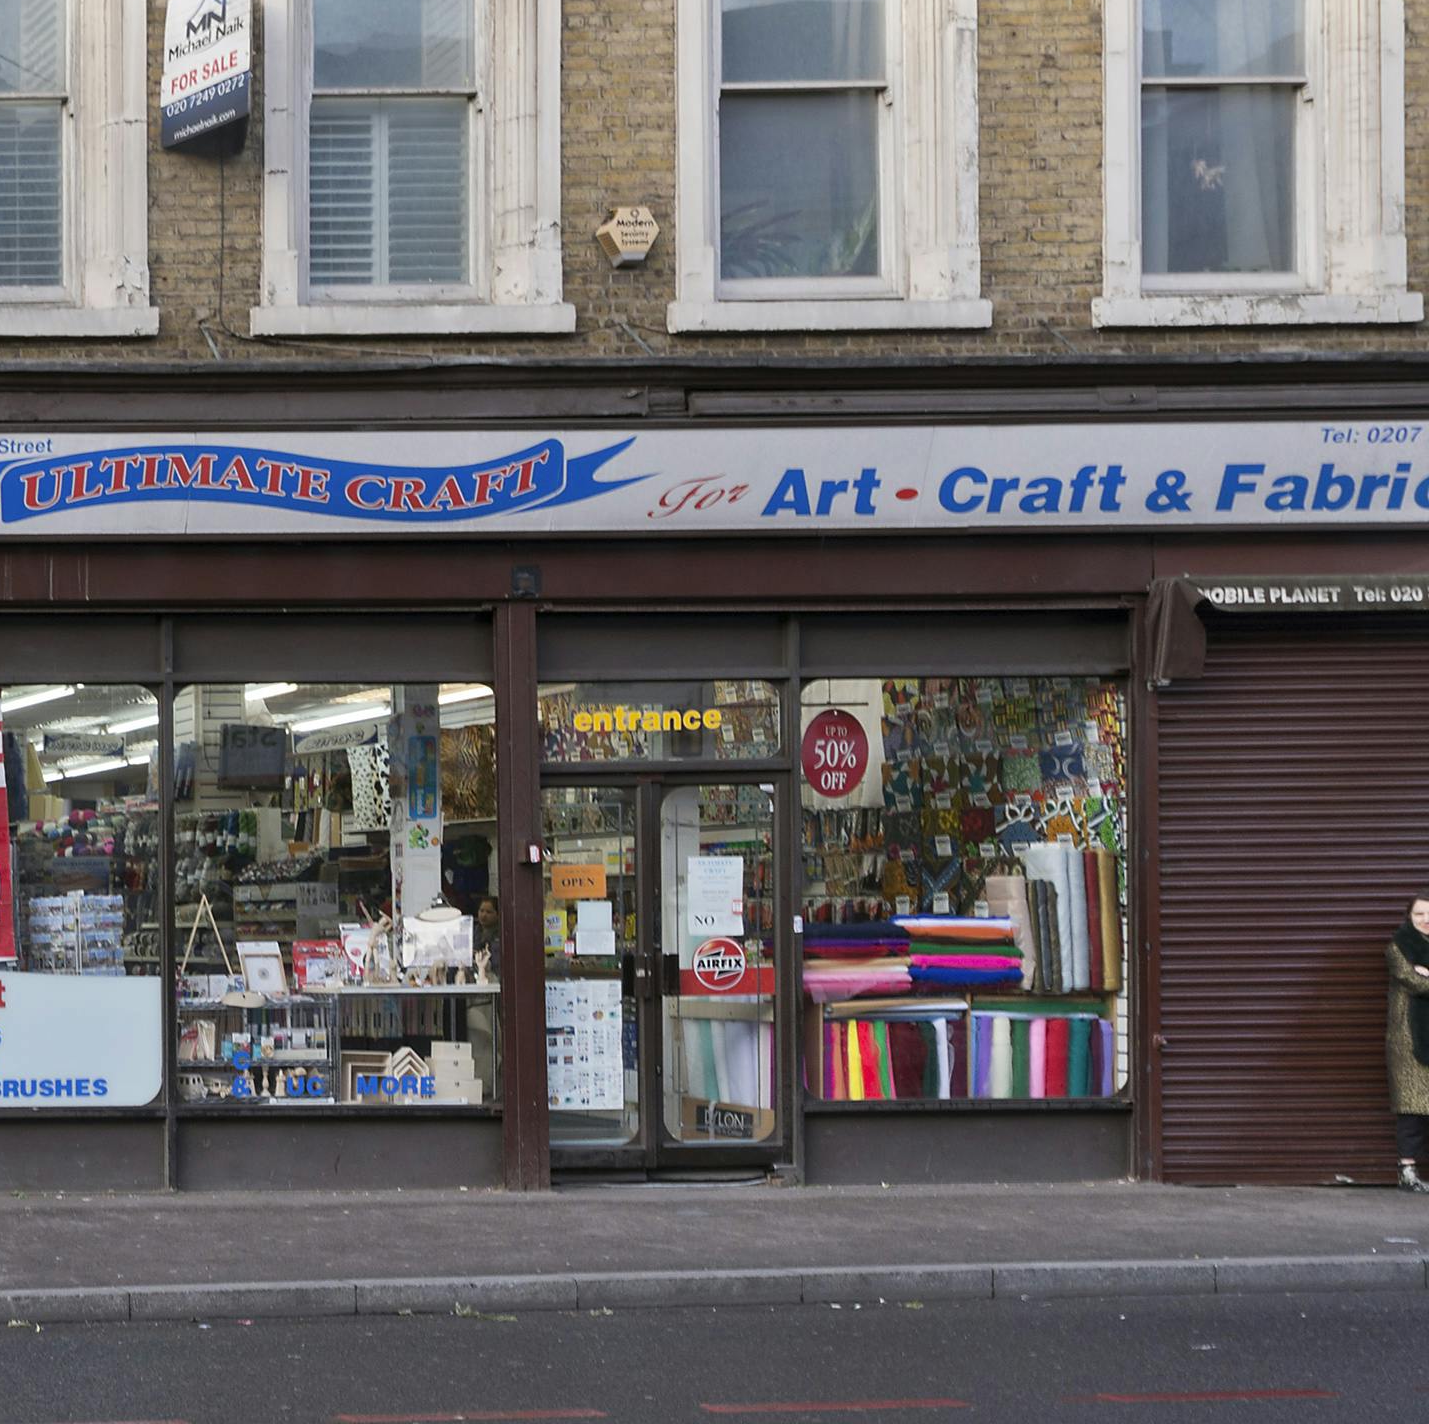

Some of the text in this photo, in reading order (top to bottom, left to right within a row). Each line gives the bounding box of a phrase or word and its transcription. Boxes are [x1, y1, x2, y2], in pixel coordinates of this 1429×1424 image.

[168, 16, 244, 62] Michael Naik
[170, 50, 238, 96] FOR SALE
[166, 74, 245, 118] 020 7249 0272
[173, 108, 236, 140] michaelnaik.com
[616, 218, 654, 227] Modern
[1320, 426, 1423, 444] Tel: 0207
[21, 448, 550, 513] ULTIMATE CRAFT
[646, 472, 751, 520] For
[760, 467, 882, 516] Art
[938, 464, 1128, 514] Craft
[1144, 469, 1193, 514] &
[1269, 585, 1341, 604] PLANET
[1352, 585, 1387, 603] Tel:
[1390, 585, 1424, 602] 020
[573, 705, 722, 732] entrance
[825, 726, 848, 736] UP TO
[813, 739, 857, 771] 50%
[820, 771, 847, 791] OFF
[561, 877, 595, 887] OPEN
[694, 915, 716, 927] NO
[697, 958, 743, 970] AIRFIX
[231, 1074, 437, 1097] & UC MORE
